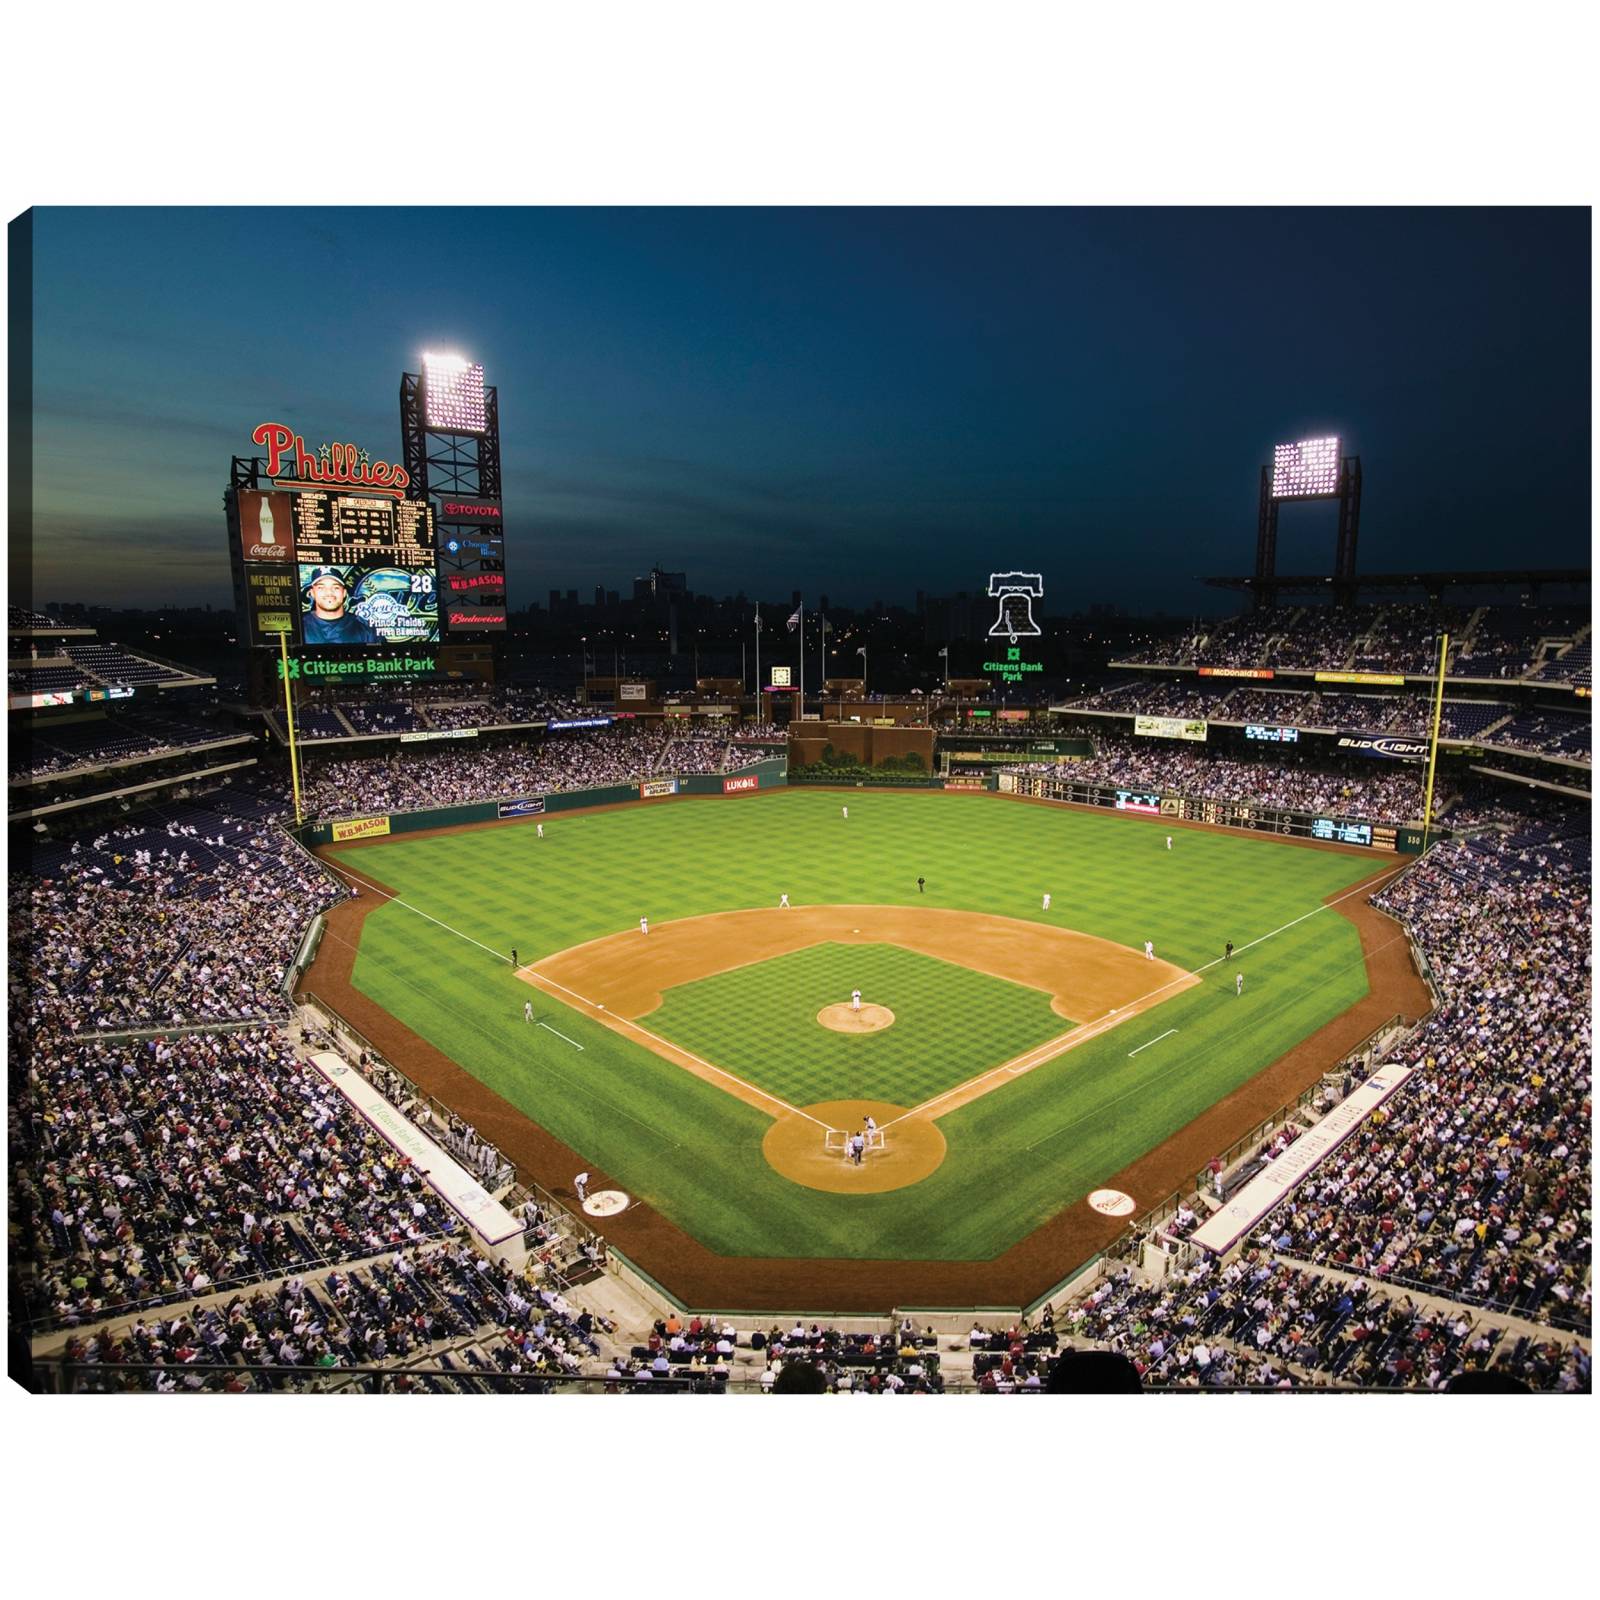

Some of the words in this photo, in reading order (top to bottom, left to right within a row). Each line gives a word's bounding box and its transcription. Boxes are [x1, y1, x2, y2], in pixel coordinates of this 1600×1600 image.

[252, 423, 410, 488] Phillies
[459, 505, 500, 516] TOYOTA
[250, 545, 288, 557] Coca-Cola
[250, 575, 292, 587] MEDICINE
[411, 575, 433, 593] 28
[256, 595, 291, 607] MUSCLE
[450, 612, 505, 624] Budweiser
[302, 660, 364, 675] Citizens
[366, 658, 402, 673] Bank
[404, 656, 436, 671] Park
[983, 662, 1020, 672] Citizens
[1020, 662, 1043, 672] Bank
[1002, 672, 1023, 681] Park
[1212, 669, 1259, 678] McDonald's
[1337, 738, 1372, 749] BUD
[1379, 741, 1429, 753] LIGHT
[726, 778, 755, 790] LUKOIL
[521, 801, 544, 809] LIGHT
[1266, 1135, 1328, 1185] PHILADELPHIA
[1323, 1104, 1364, 1132] PHILLIES
